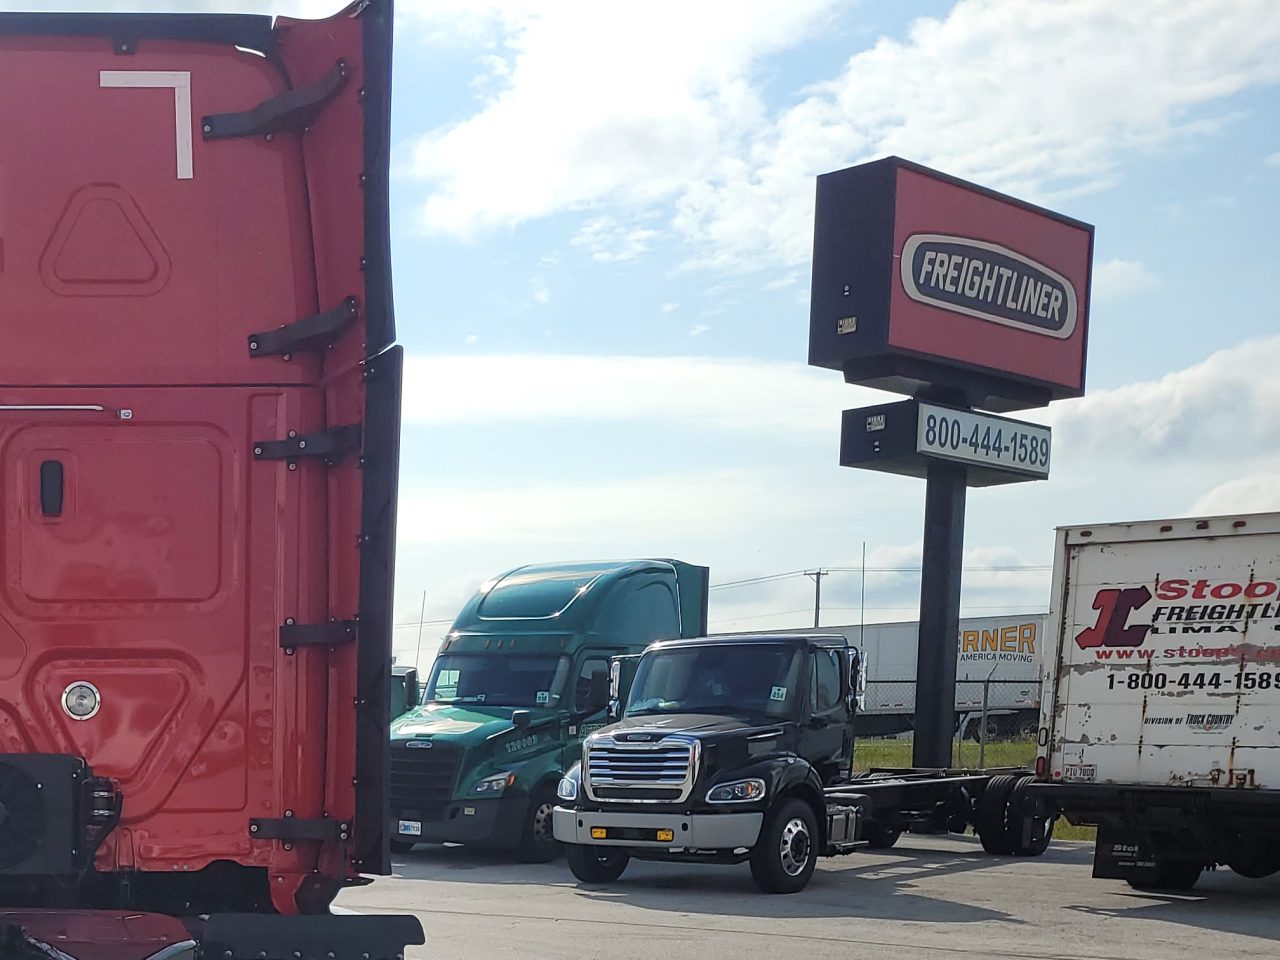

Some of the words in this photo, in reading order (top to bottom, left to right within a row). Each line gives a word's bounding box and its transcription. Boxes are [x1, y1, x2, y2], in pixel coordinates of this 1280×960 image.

[919, 251, 1063, 321] FREIGHTLINER
[925, 414, 1049, 467] 800-444-1589
[1156, 579, 1280, 601] Stoo
[958, 623, 1036, 653] RNER
[960, 653, 997, 662] AMERICA
[999, 653, 1033, 663] MOVING
[1144, 717, 1173, 725] DIVISION
[1174, 717, 1184, 725] OF
[1186, 713, 1206, 725] TRUCK
[1206, 713, 1235, 725] COUNTRY
